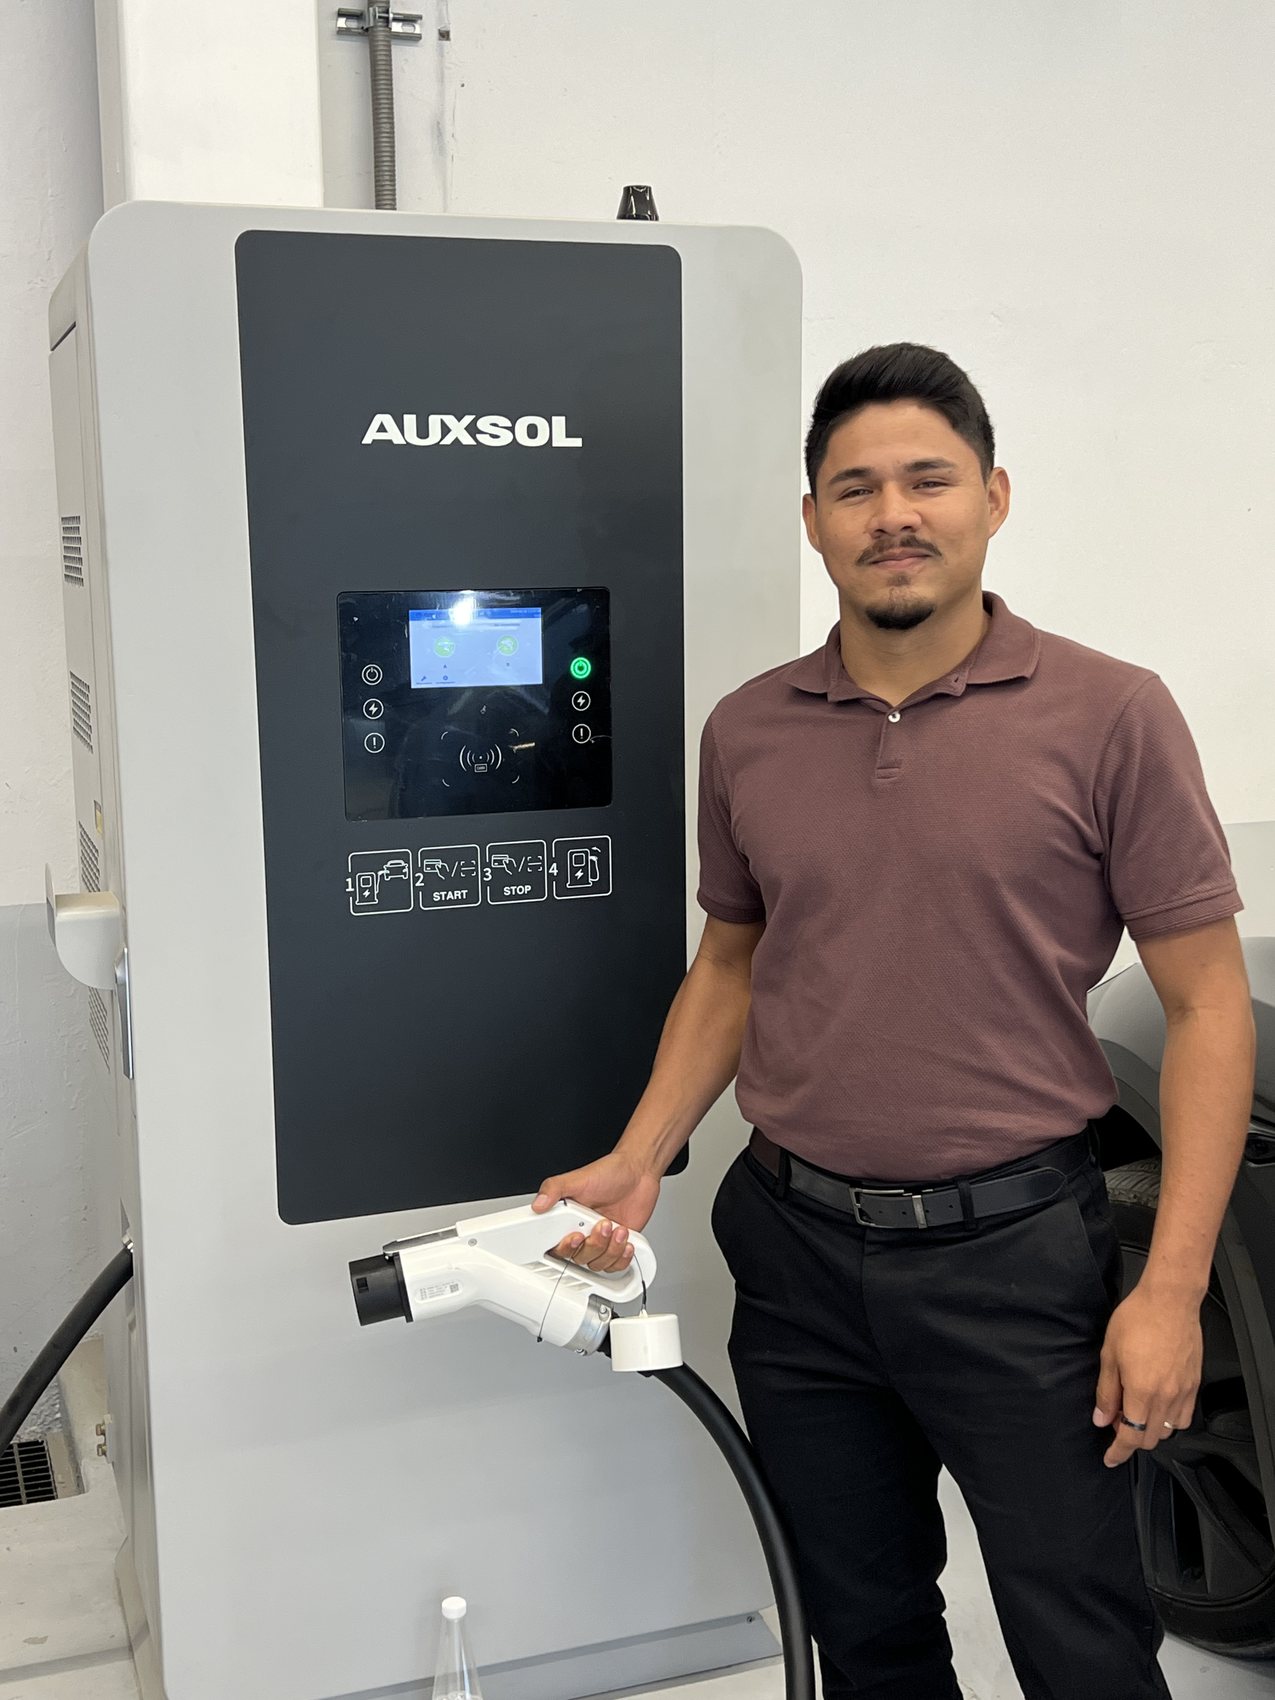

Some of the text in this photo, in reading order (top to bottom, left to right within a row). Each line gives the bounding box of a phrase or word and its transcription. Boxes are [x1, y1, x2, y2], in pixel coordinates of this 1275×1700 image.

[361, 413, 583, 448] AUXSOL
[482, 867, 493, 882] 3
[548, 862, 559, 877] 4
[345, 877, 355, 892] 1
[414, 872, 425, 887] 2
[432, 889, 469, 902] START
[503, 884, 532, 897] STOP
